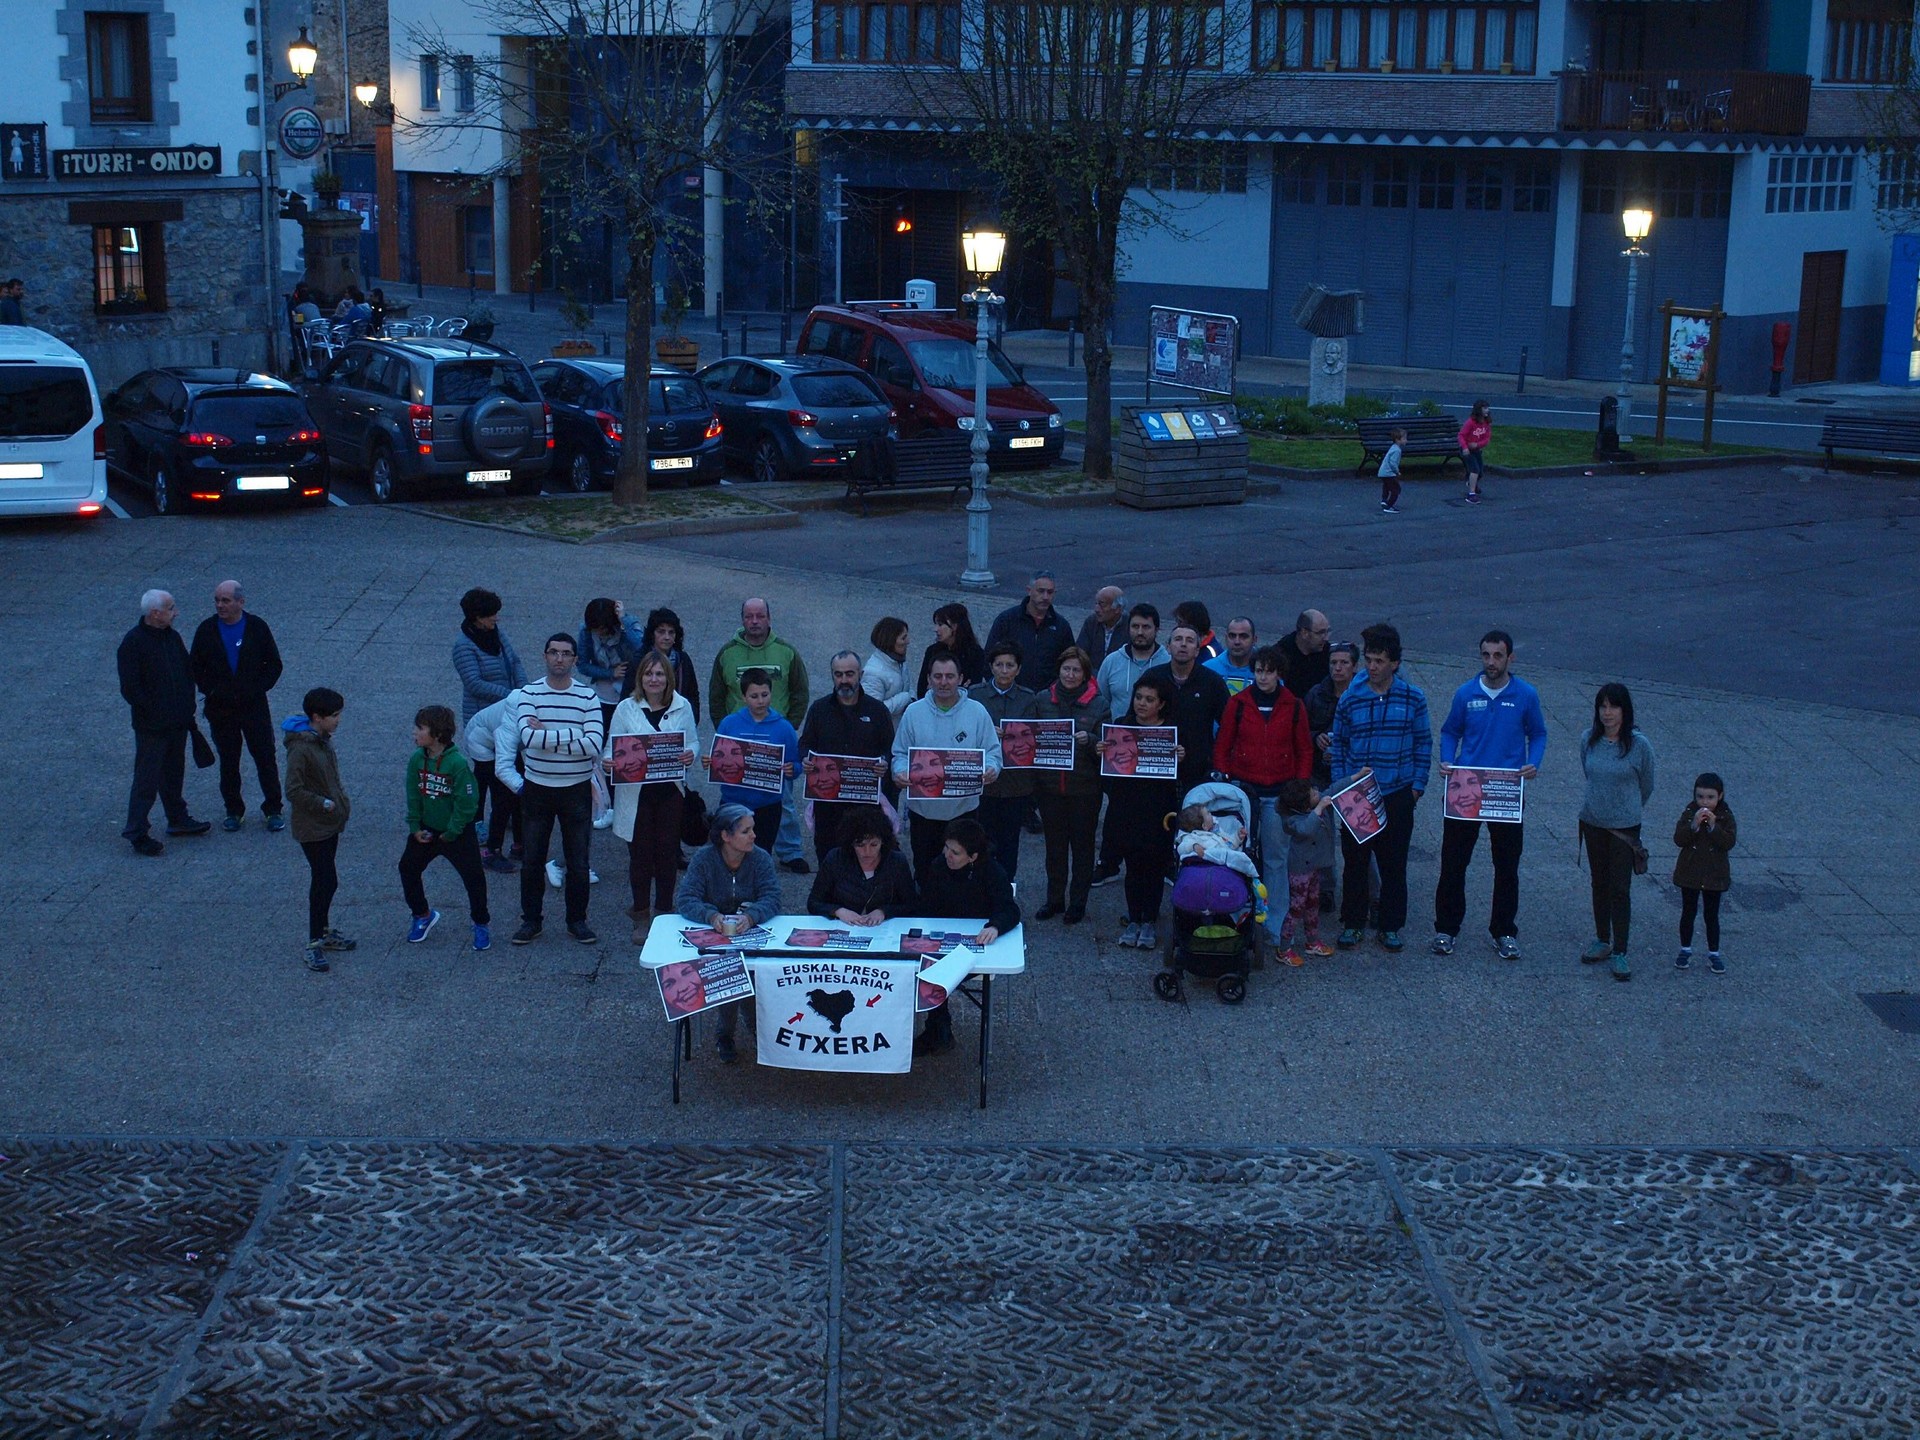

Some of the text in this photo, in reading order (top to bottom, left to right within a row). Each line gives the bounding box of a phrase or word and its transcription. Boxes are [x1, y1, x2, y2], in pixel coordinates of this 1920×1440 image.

[288, 128, 320, 137] Heineken
[150, 151, 214, 172] ONDO
[480, 426, 529, 436] SUZUKI
[472, 472, 490, 481] 7781
[698, 956, 743, 974] KONTZENTRAZIOA
[783, 963, 890, 980] EUSKAL PRESO
[704, 972, 747, 991] MANIFESTAZIOA
[776, 974, 894, 993] ETA IHESLARIAK
[775, 1027, 891, 1055] ETXERA
